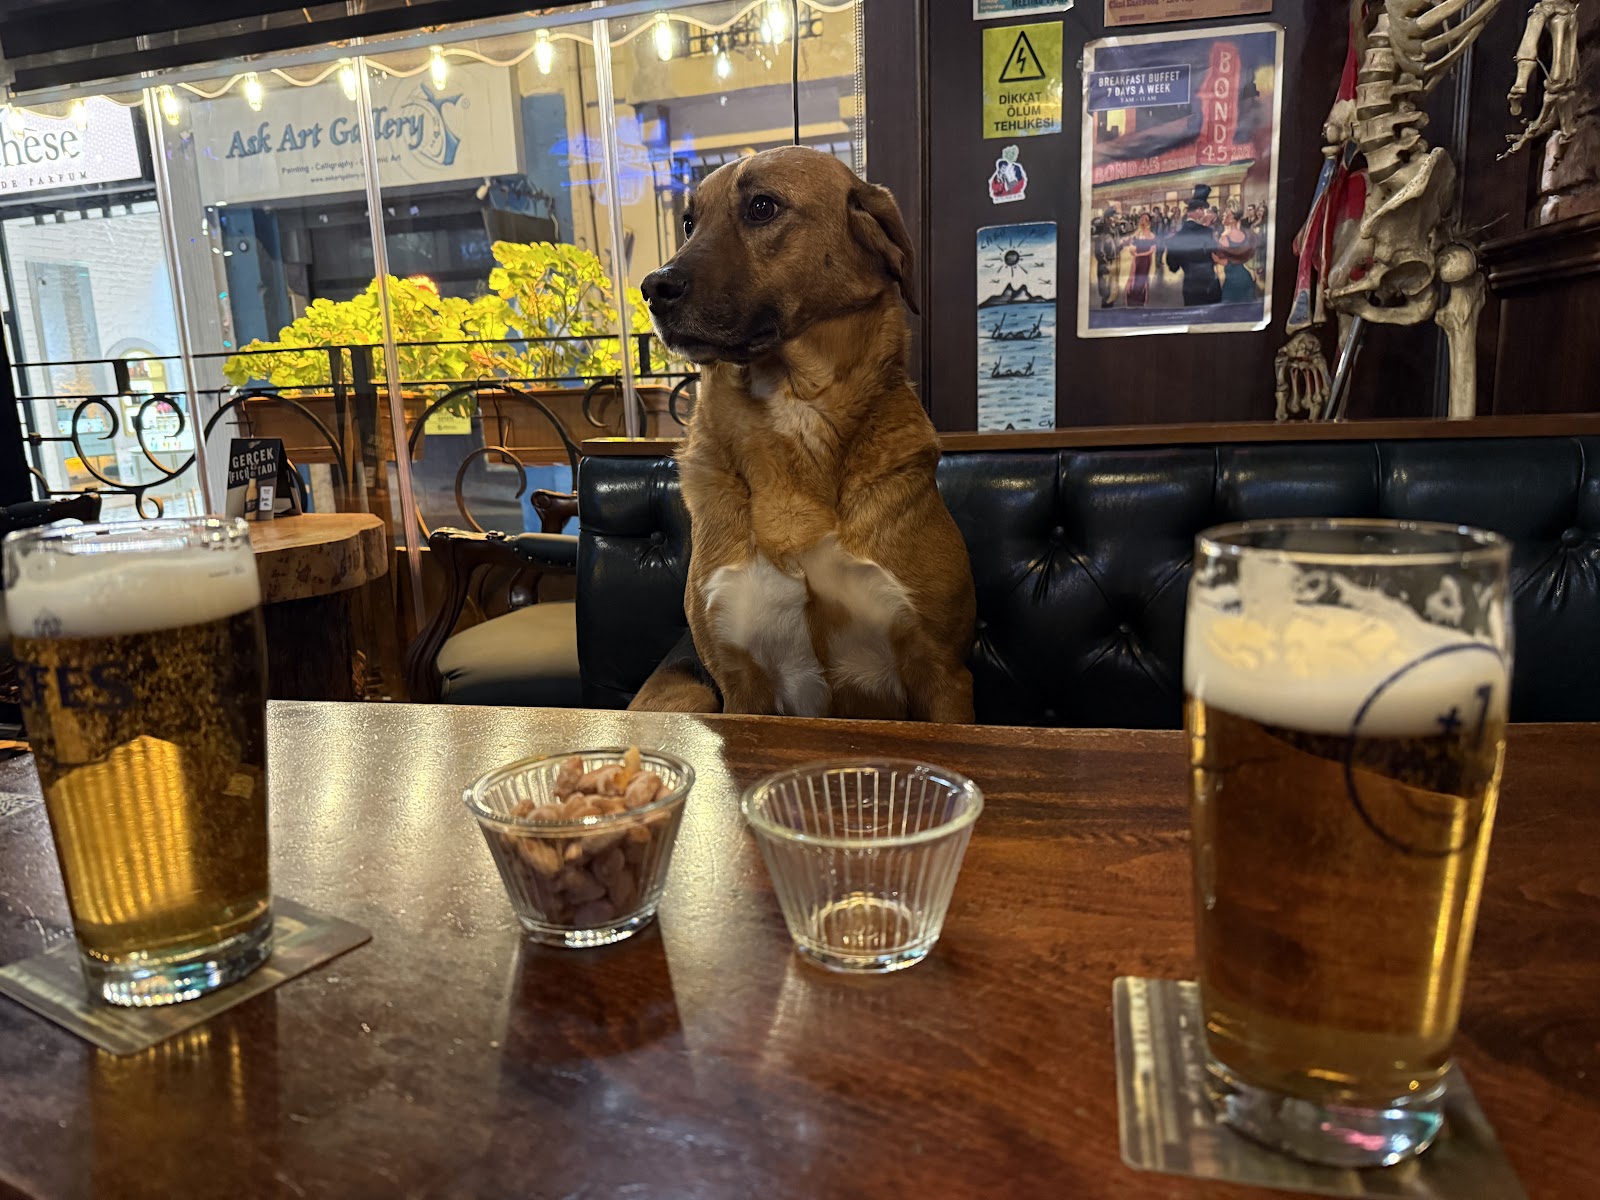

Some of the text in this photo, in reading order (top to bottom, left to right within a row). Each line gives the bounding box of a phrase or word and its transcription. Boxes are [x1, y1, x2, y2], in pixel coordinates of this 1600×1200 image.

[1098, 70, 1180, 87] BREAKFAST BUFFET
[999, 92, 1042, 105] DİKKAT
[1107, 83, 1171, 97] 7 DAYS A WEEK
[1007, 103, 1041, 117] ÖLÜM
[994, 117, 1054, 131] TEHLİKESİ
[225, 121, 272, 159] Ask
[276, 123, 323, 152] Art
[29, 170, 88, 187] PARFUM
[1094, 160, 1138, 185] BOND
[232, 447, 274, 469] GERÇEK
